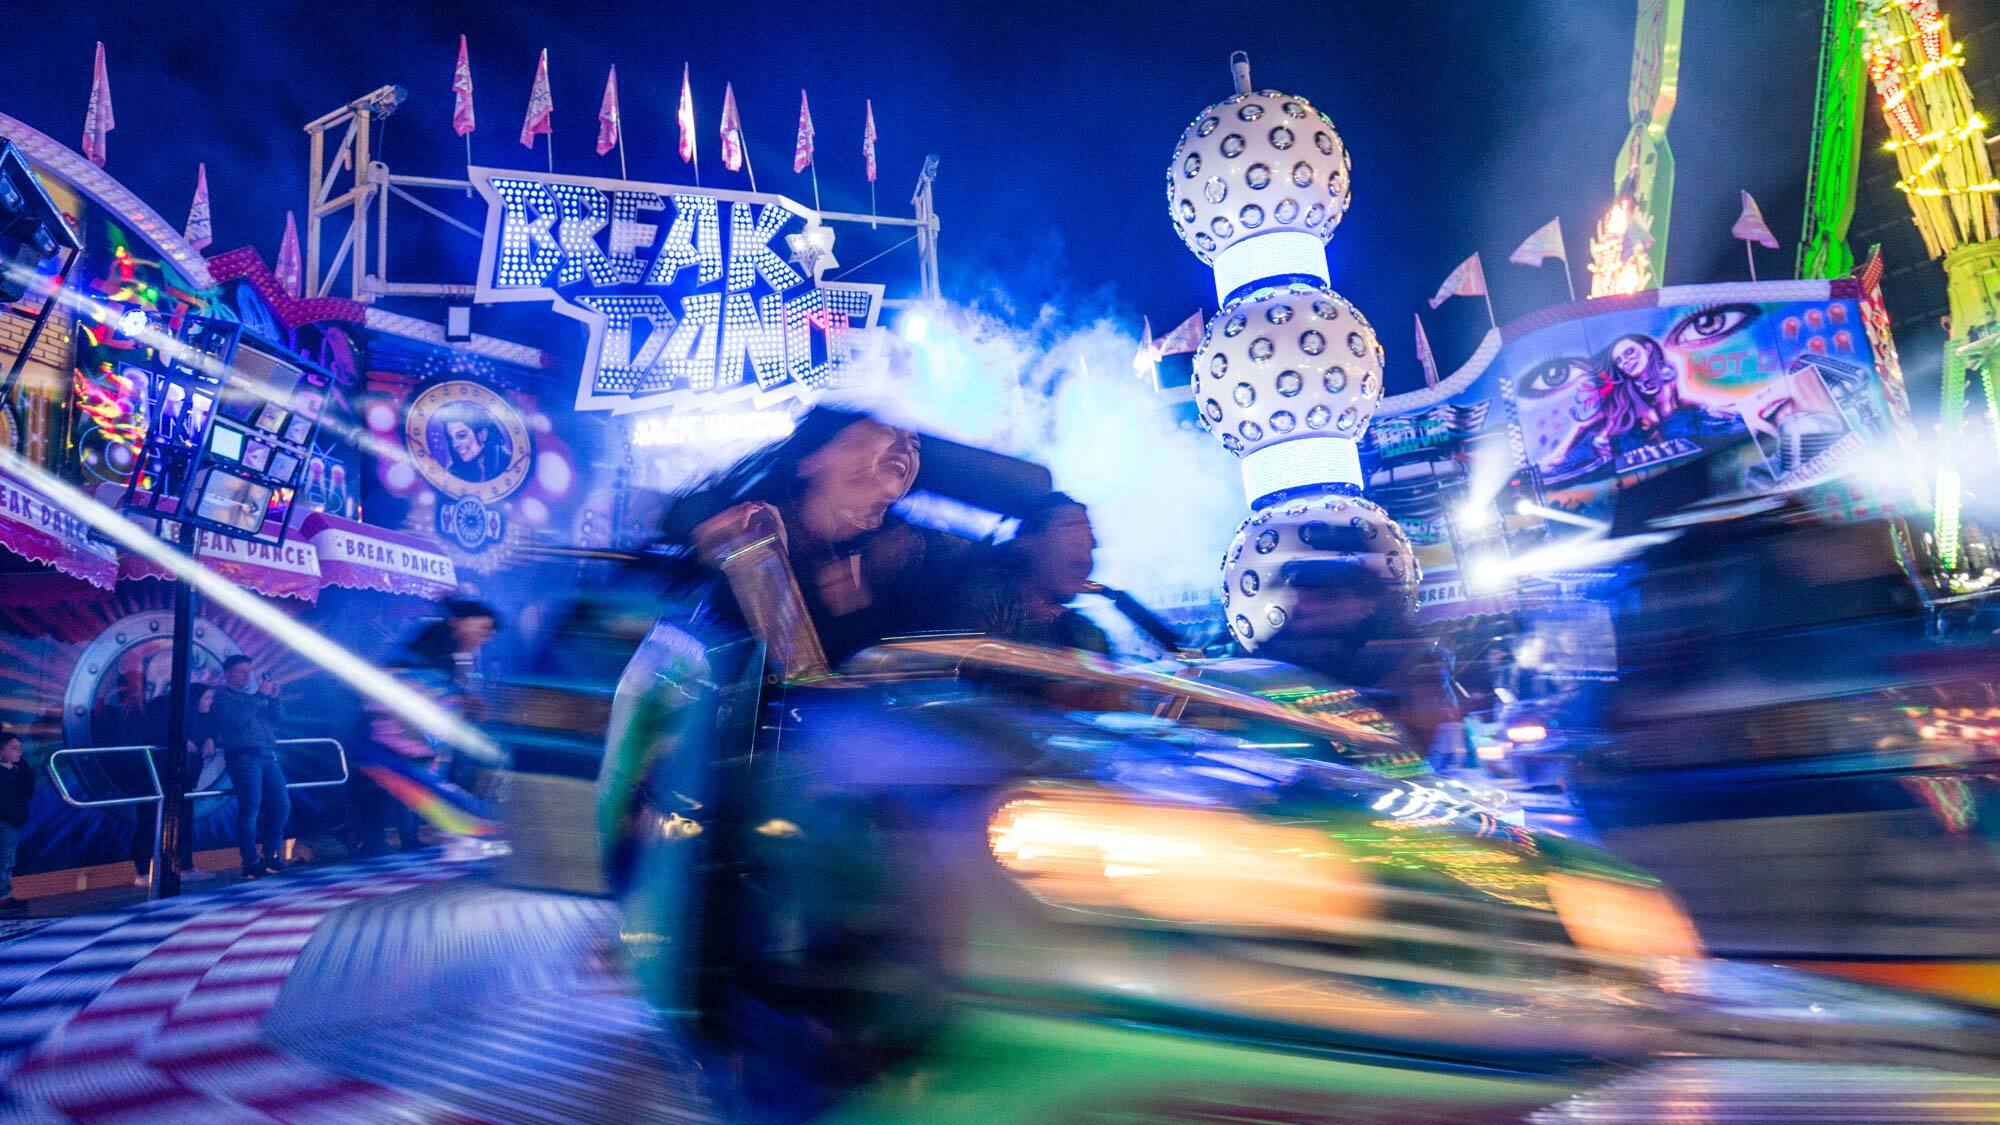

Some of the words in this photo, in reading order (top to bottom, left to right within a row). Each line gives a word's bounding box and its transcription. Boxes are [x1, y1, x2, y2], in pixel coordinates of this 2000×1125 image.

[489, 176, 805, 293] BREAK
[248, 541, 306, 567] DANCE
[345, 538, 395, 566] BREAK
[401, 551, 446, 577] DANCE
